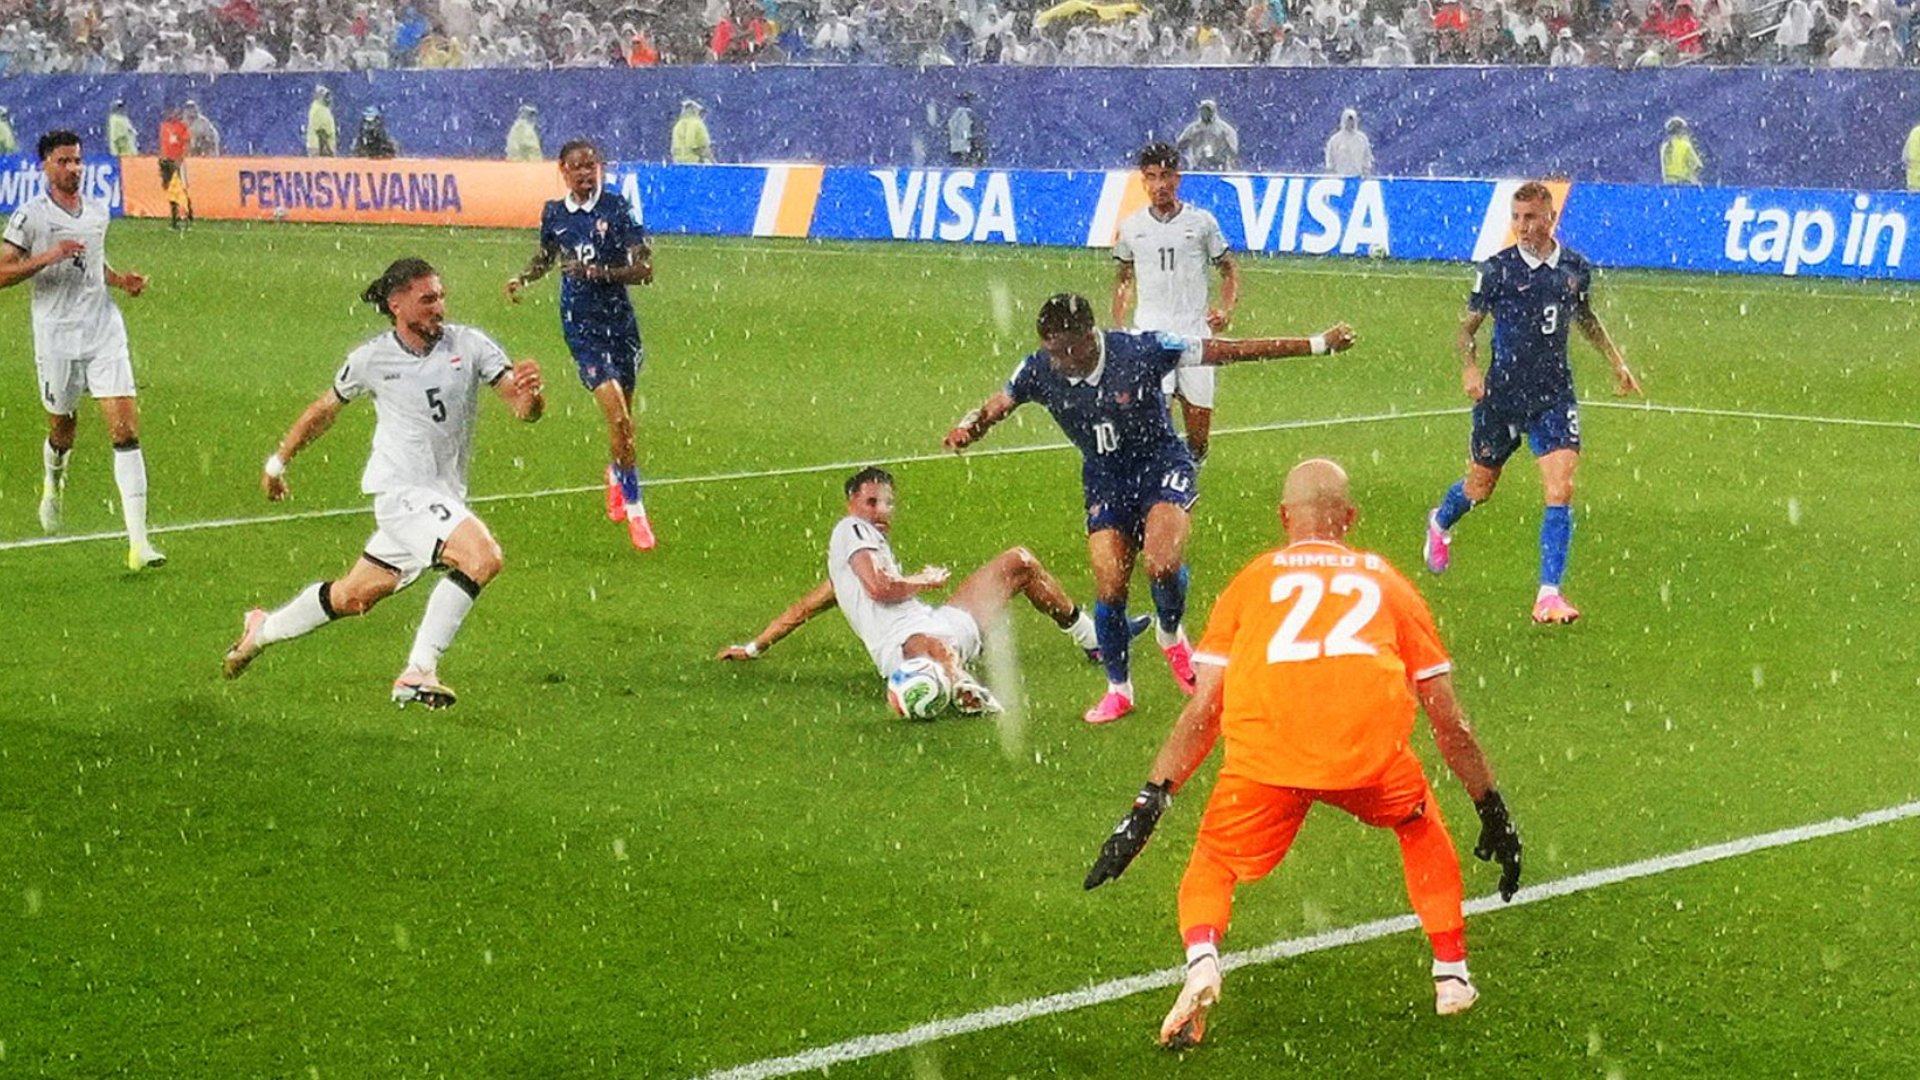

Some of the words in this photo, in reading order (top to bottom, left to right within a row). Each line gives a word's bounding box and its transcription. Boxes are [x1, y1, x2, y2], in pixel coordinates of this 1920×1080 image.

[239, 170, 462, 213] PENNSYLVANIA
[869, 171, 1018, 243] VISA
[1223, 176, 1391, 255] VISA
[1723, 196, 1837, 275] tap
[1843, 194, 1908, 267] in
[574, 243, 595, 266] 12
[1158, 247, 1175, 271] 11
[1541, 306, 1558, 335] 3
[45, 381, 56, 406] 4
[425, 387, 447, 424] 5
[1092, 422, 1118, 455] 10
[1566, 409, 1580, 436] 3
[1272, 554, 1355, 568] AHMED
[1267, 572, 1382, 665] 22
